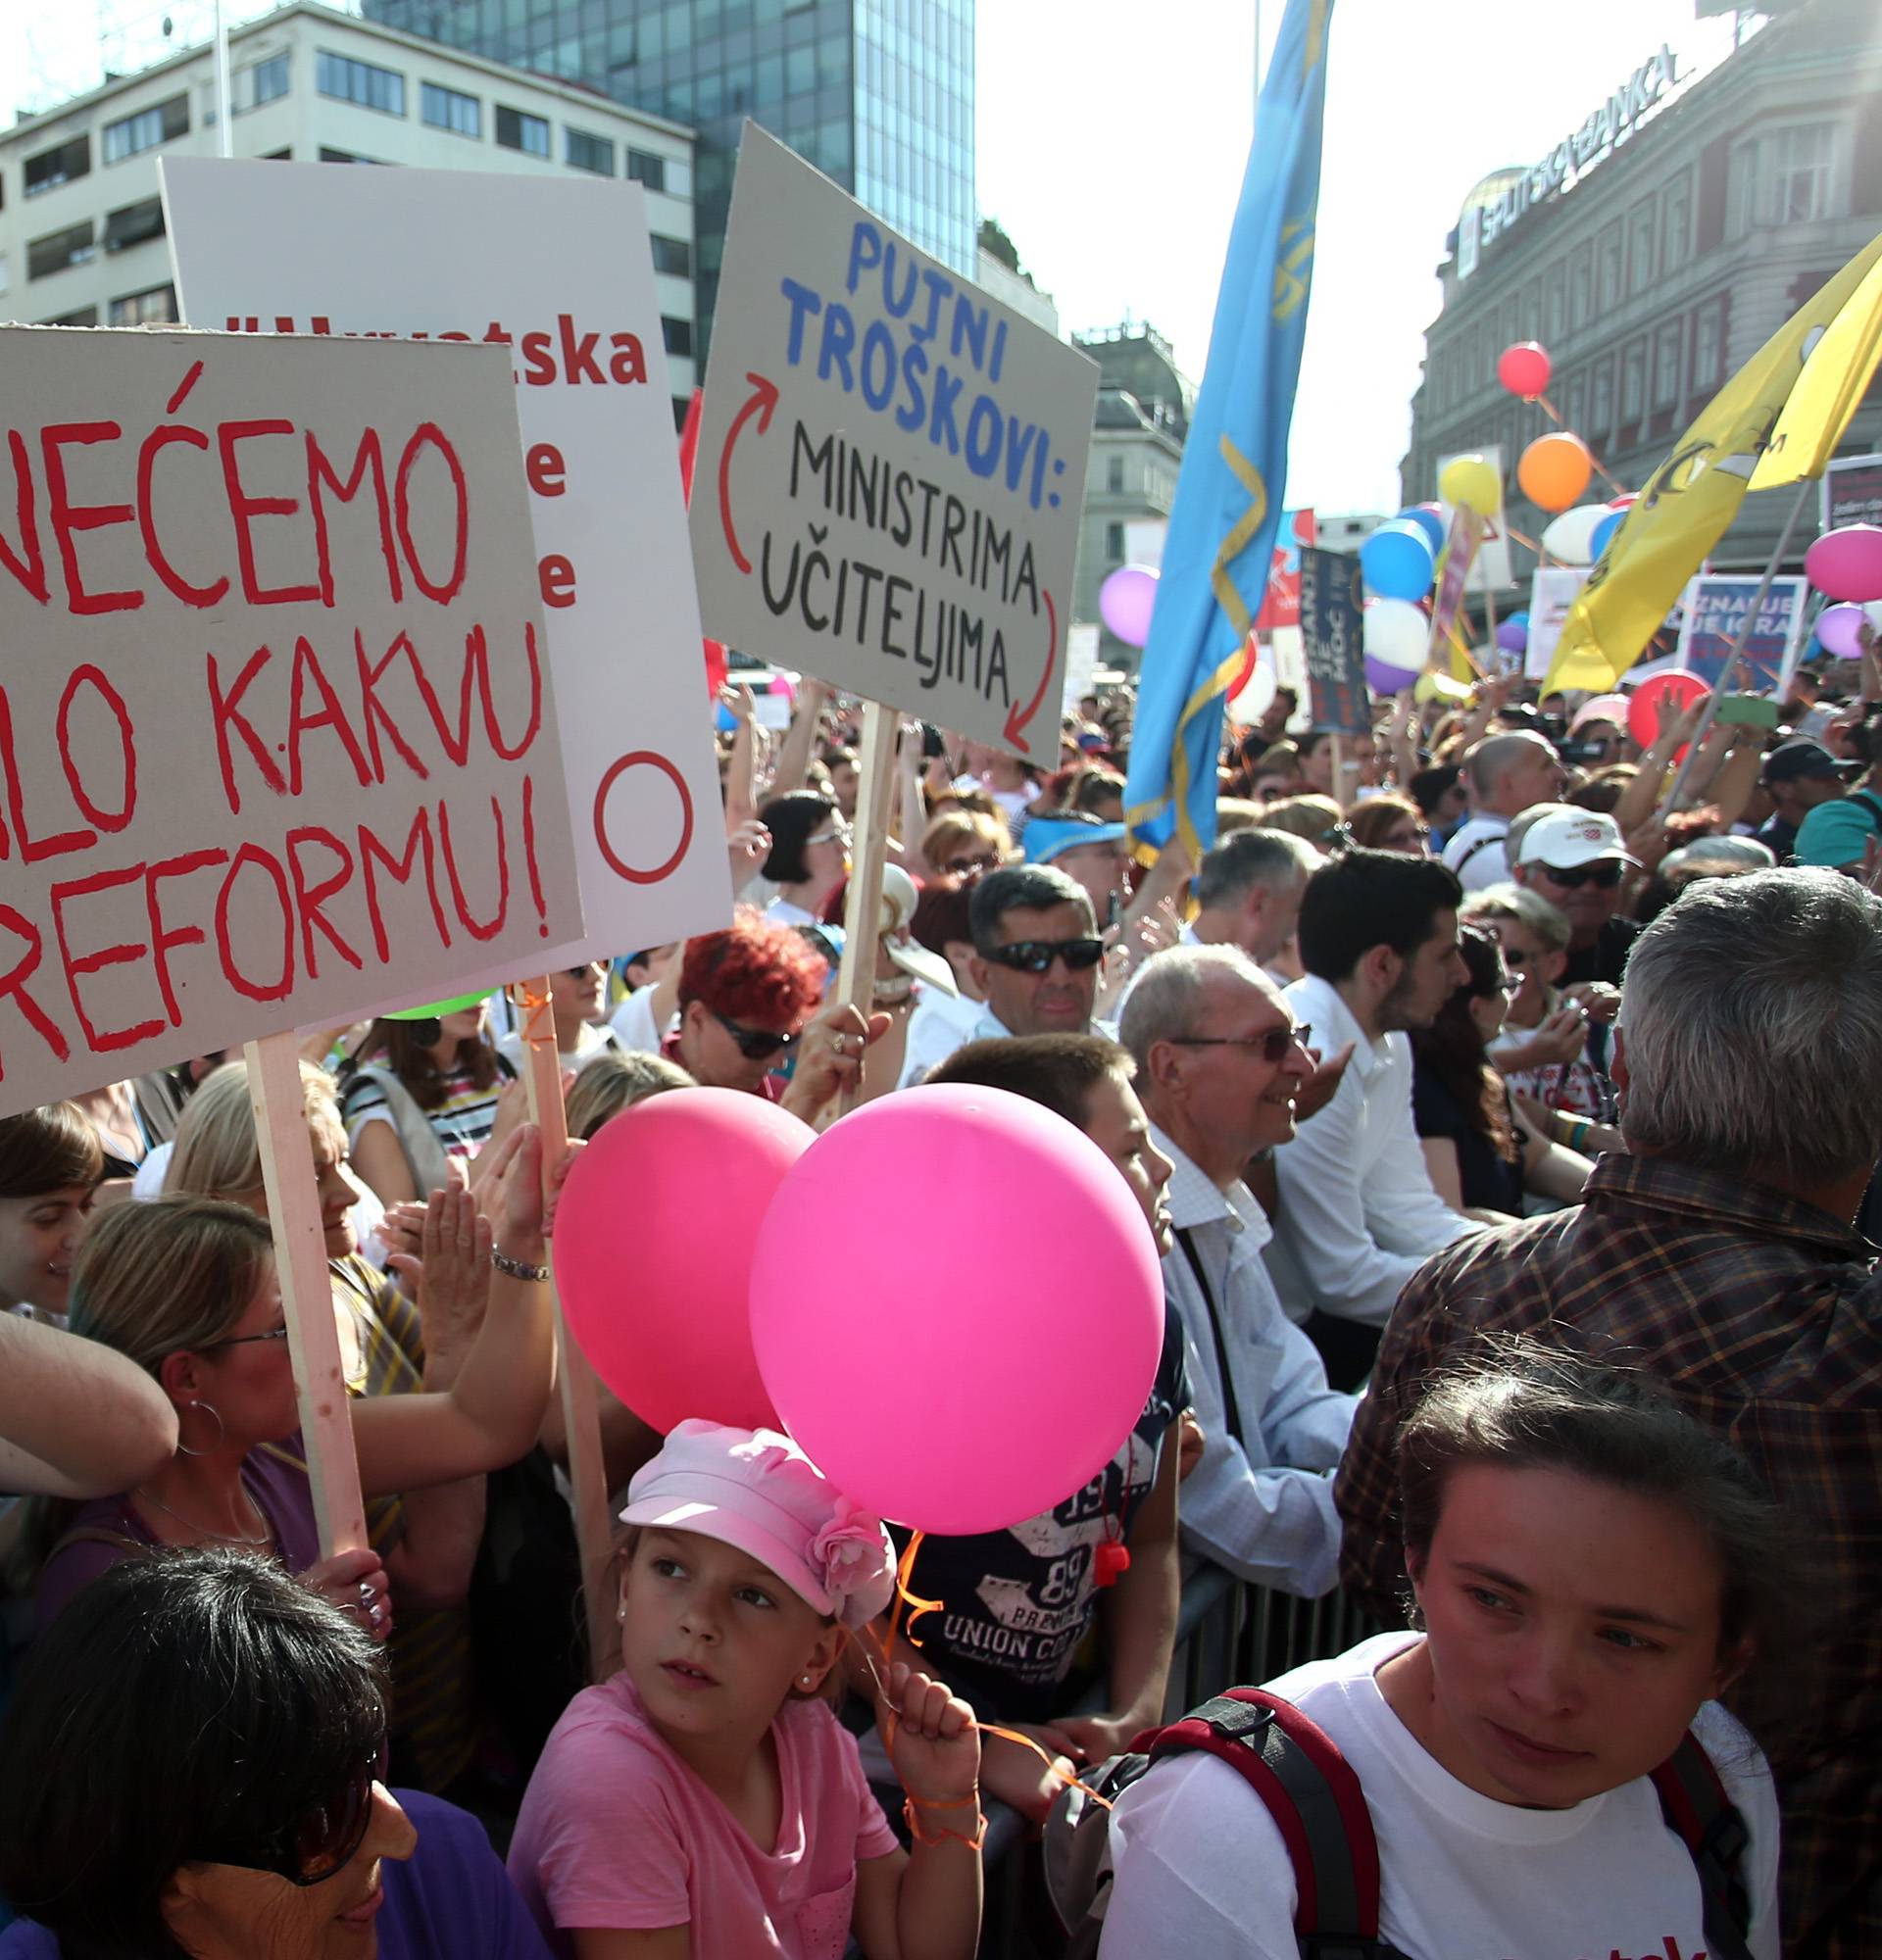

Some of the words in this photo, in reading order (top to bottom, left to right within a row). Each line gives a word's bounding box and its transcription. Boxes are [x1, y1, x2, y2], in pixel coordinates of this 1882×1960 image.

[781, 277, 1066, 510] TROŠKOVI:
[846, 221, 1009, 384] PUTNI
[0, 361, 469, 615] NEĆEMO
[525, 442, 567, 498] e
[789, 419, 1039, 615] MINISTRIMA
[538, 553, 577, 609] e
[761, 522, 1011, 708] UČITELJIMA
[206, 621, 542, 815] KAKVU
[0, 774, 550, 1078] REFORMU!
[943, 1614, 1030, 1659] UNION
[1040, 1550, 1083, 1605] 89
